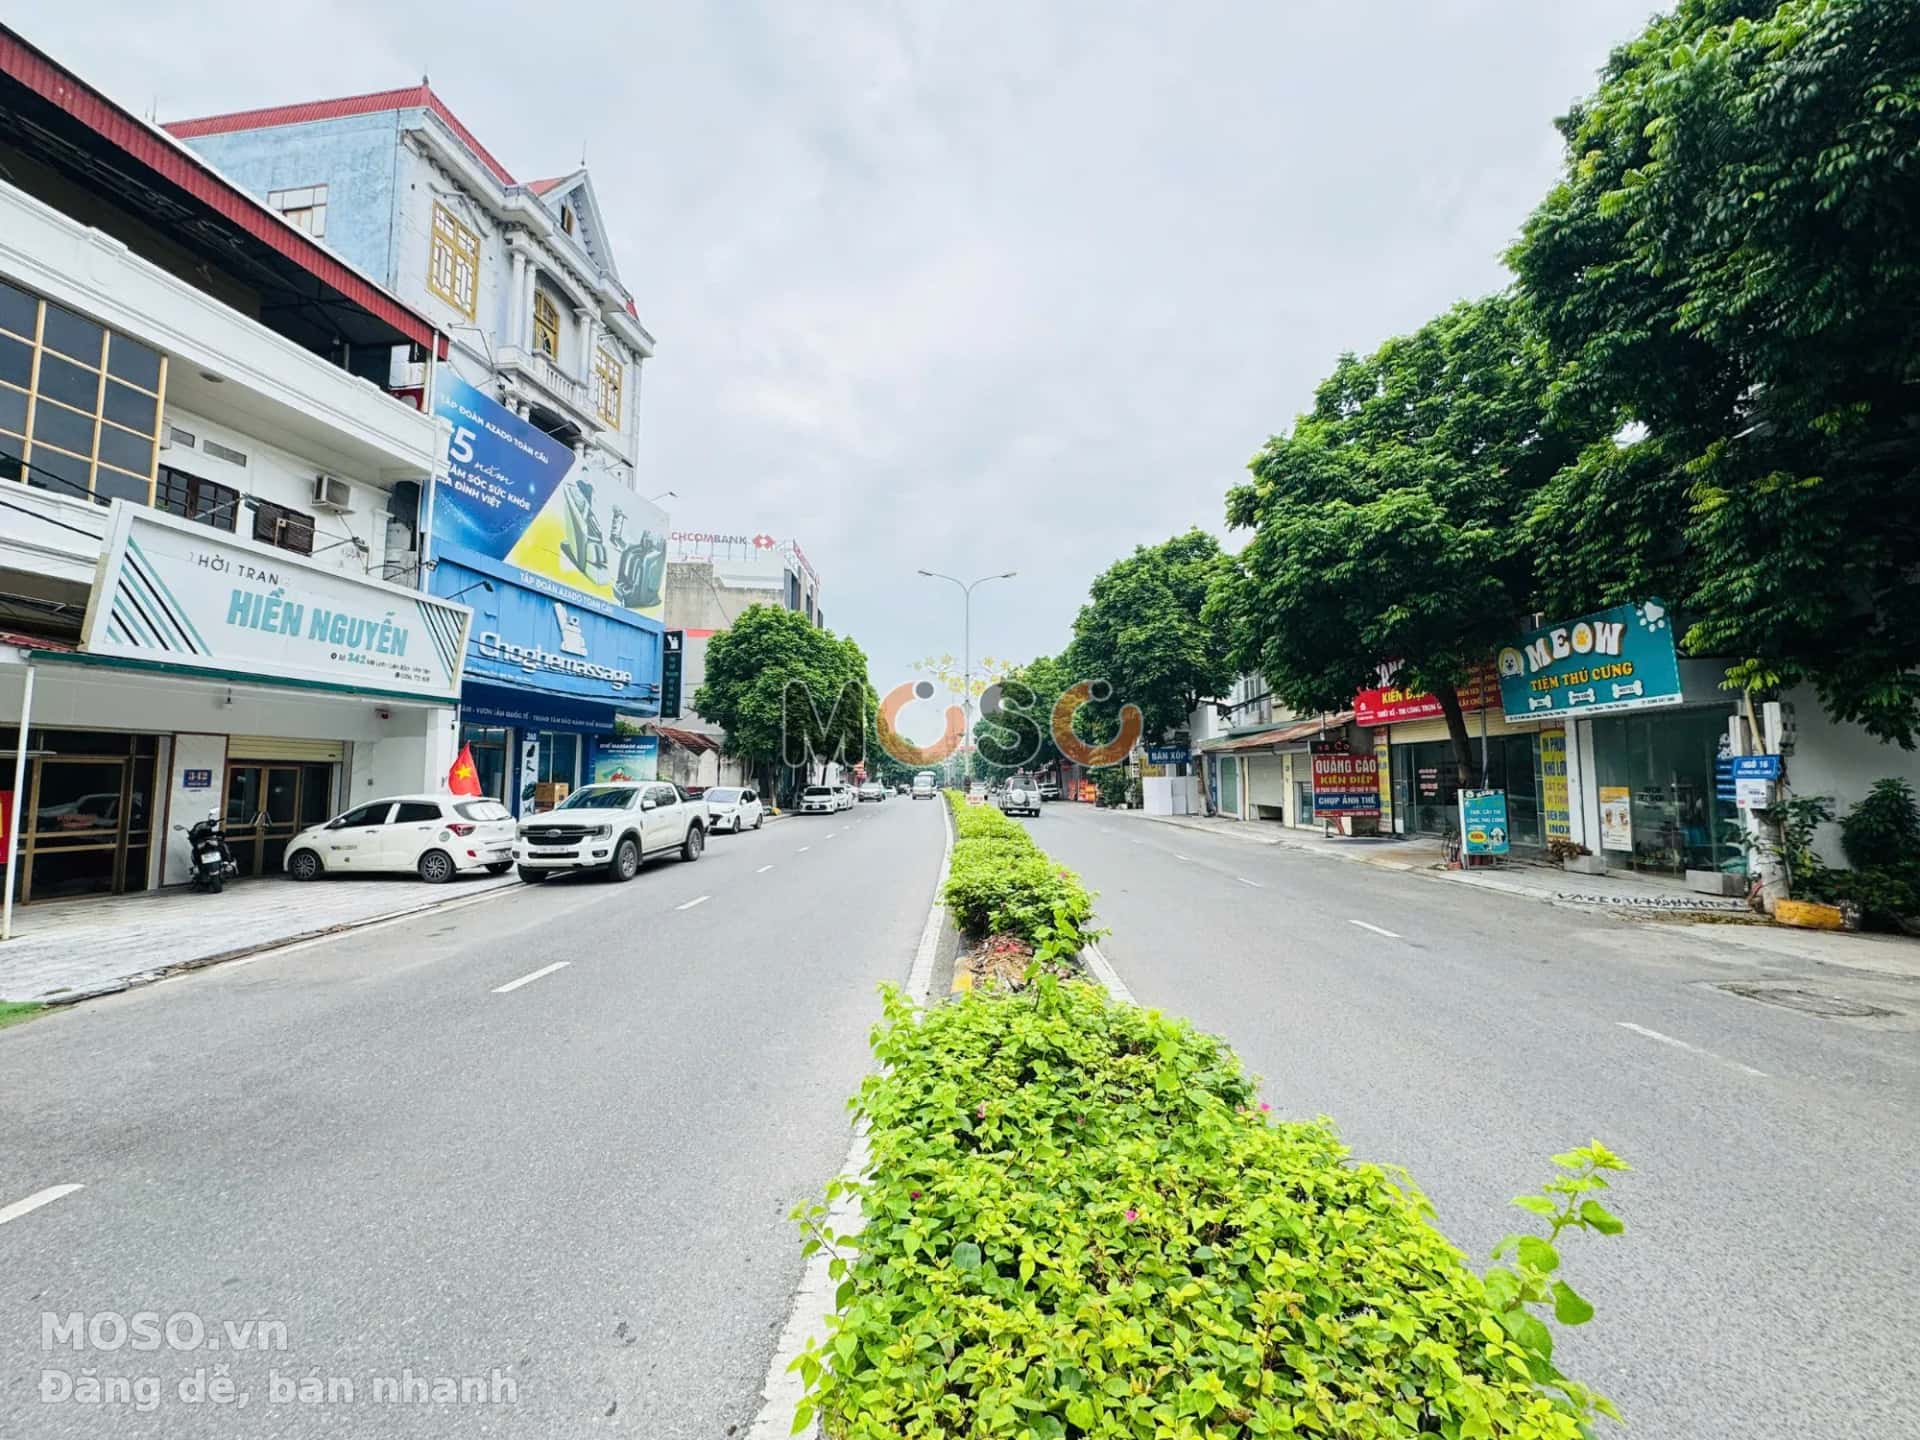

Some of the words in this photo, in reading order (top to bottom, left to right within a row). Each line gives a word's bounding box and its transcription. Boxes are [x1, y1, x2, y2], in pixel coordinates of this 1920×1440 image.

[450, 425, 477, 464] 5
[485, 421, 513, 442] AZADO
[669, 531, 748, 545] CHCOMBANK
[226, 586, 304, 638] HIỀN
[308, 612, 409, 657] NGUYỄN
[1524, 620, 1626, 673] MEOW
[1530, 673, 1560, 693] TIỆM
[1563, 666, 1589, 686] THÚ
[1592, 661, 1634, 681] CƯNG
[1315, 756, 1353, 774] QUẢNG
[1355, 757, 1377, 774] CÁO
[1318, 796, 1340, 807] CHỤP
[1342, 794, 1360, 805] ẢNH
[1361, 793, 1377, 805] THẺ
